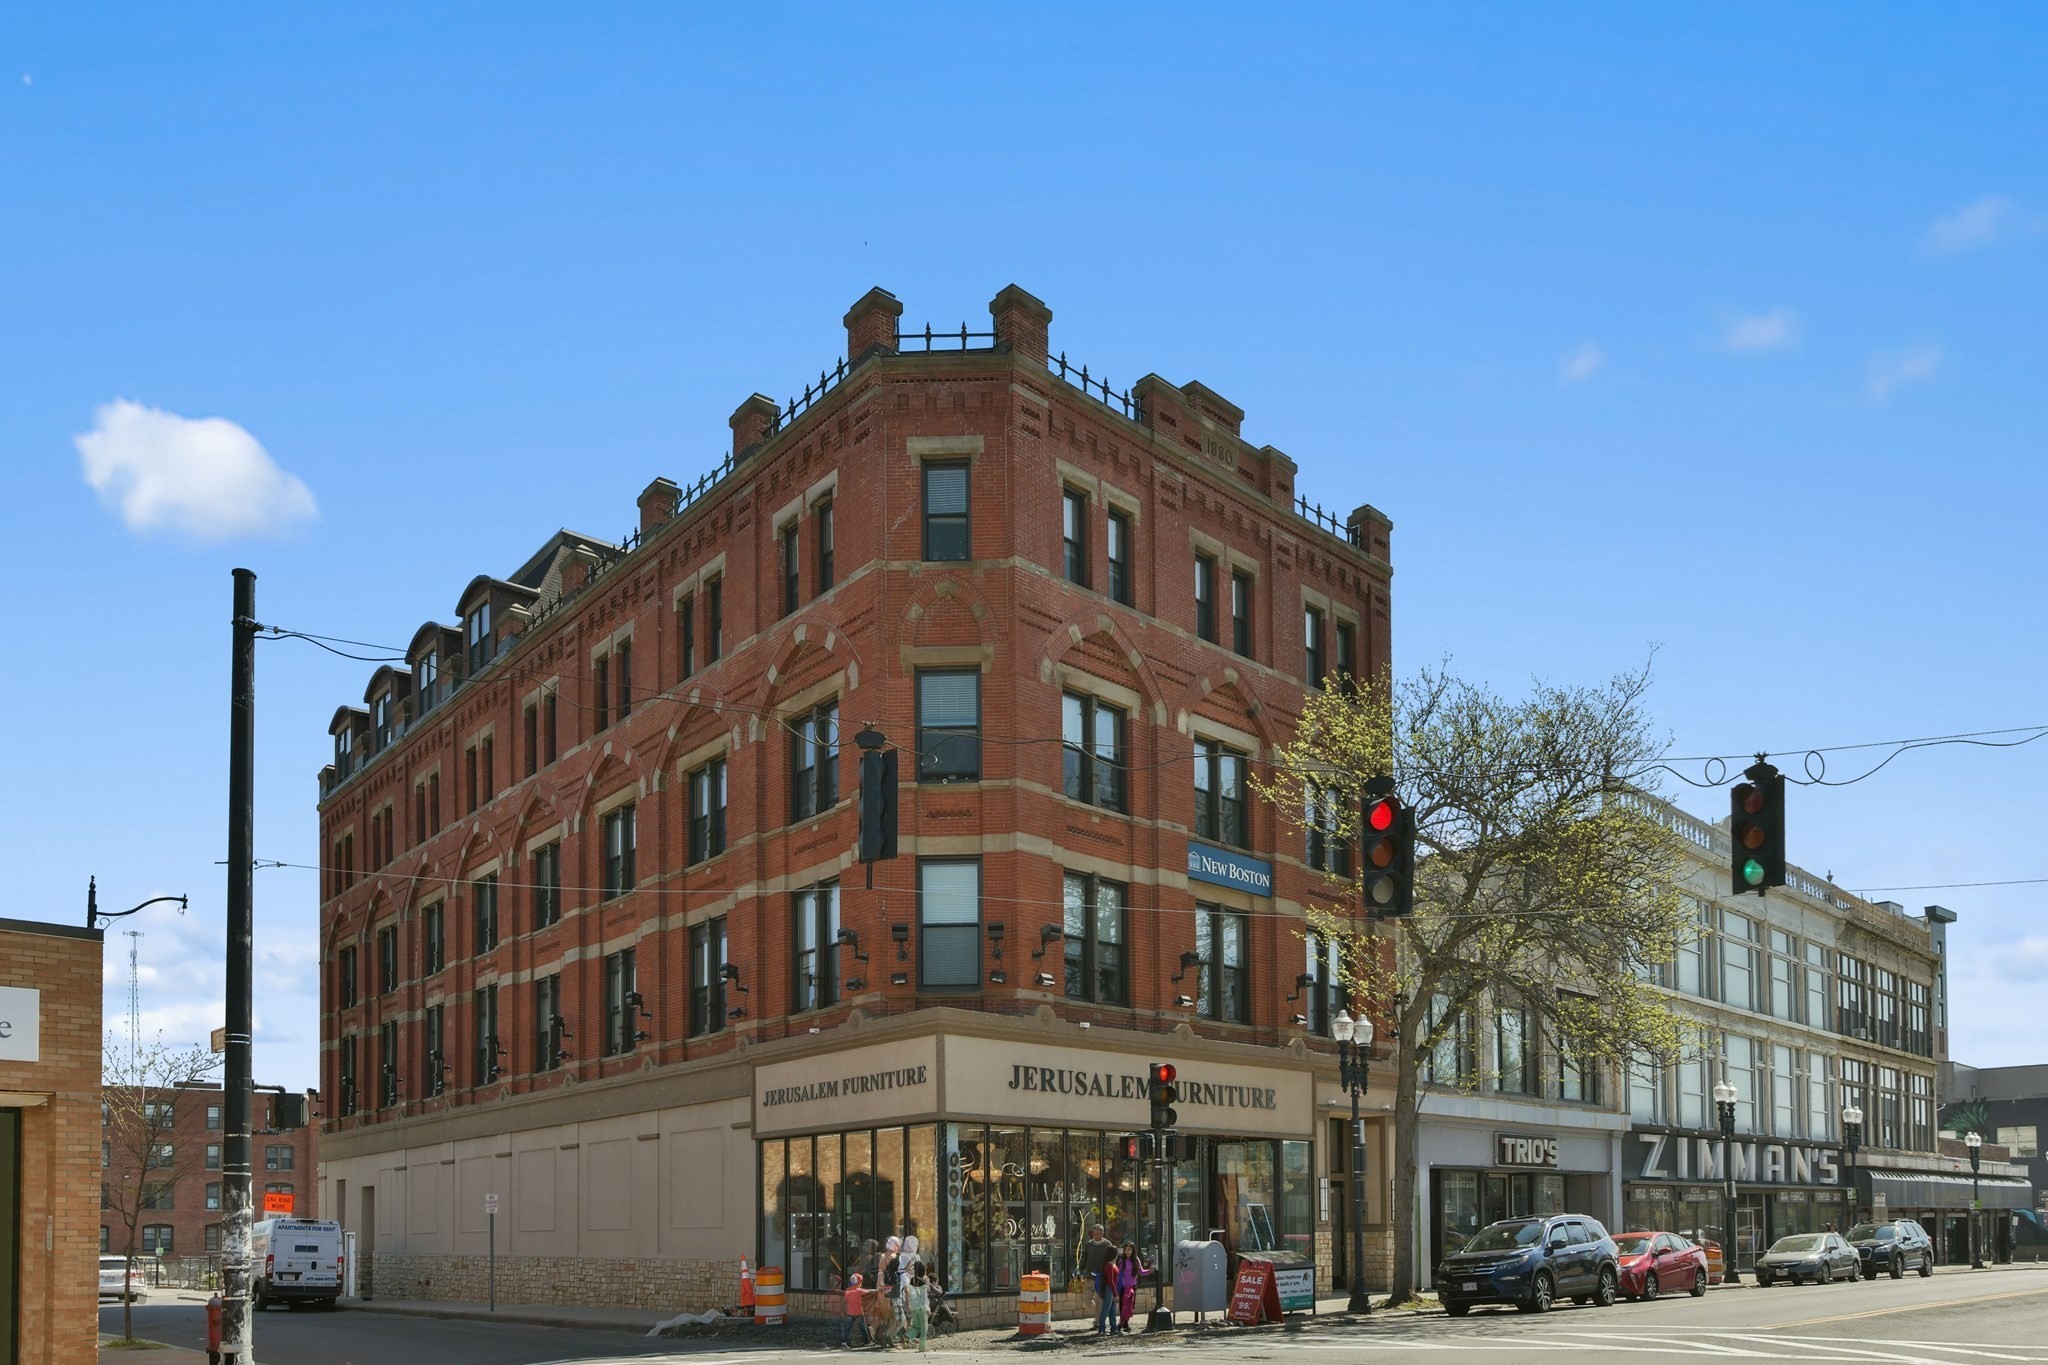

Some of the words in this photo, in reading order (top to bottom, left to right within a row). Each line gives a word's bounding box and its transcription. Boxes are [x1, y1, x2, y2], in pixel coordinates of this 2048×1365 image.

[1207, 438, 1233, 465] 1880
[763, 1080, 839, 1107] JERUSALEM
[842, 1065, 927, 1096] FURNITURE
[1008, 1064, 1151, 1100] JERUSALEM
[1169, 1081, 1277, 1110] URNITURE
[1501, 1137, 1559, 1165] TRIO'S
[1639, 1134, 1838, 1185] ZIMMAN'S
[1240, 1275, 1263, 1285] SALE
